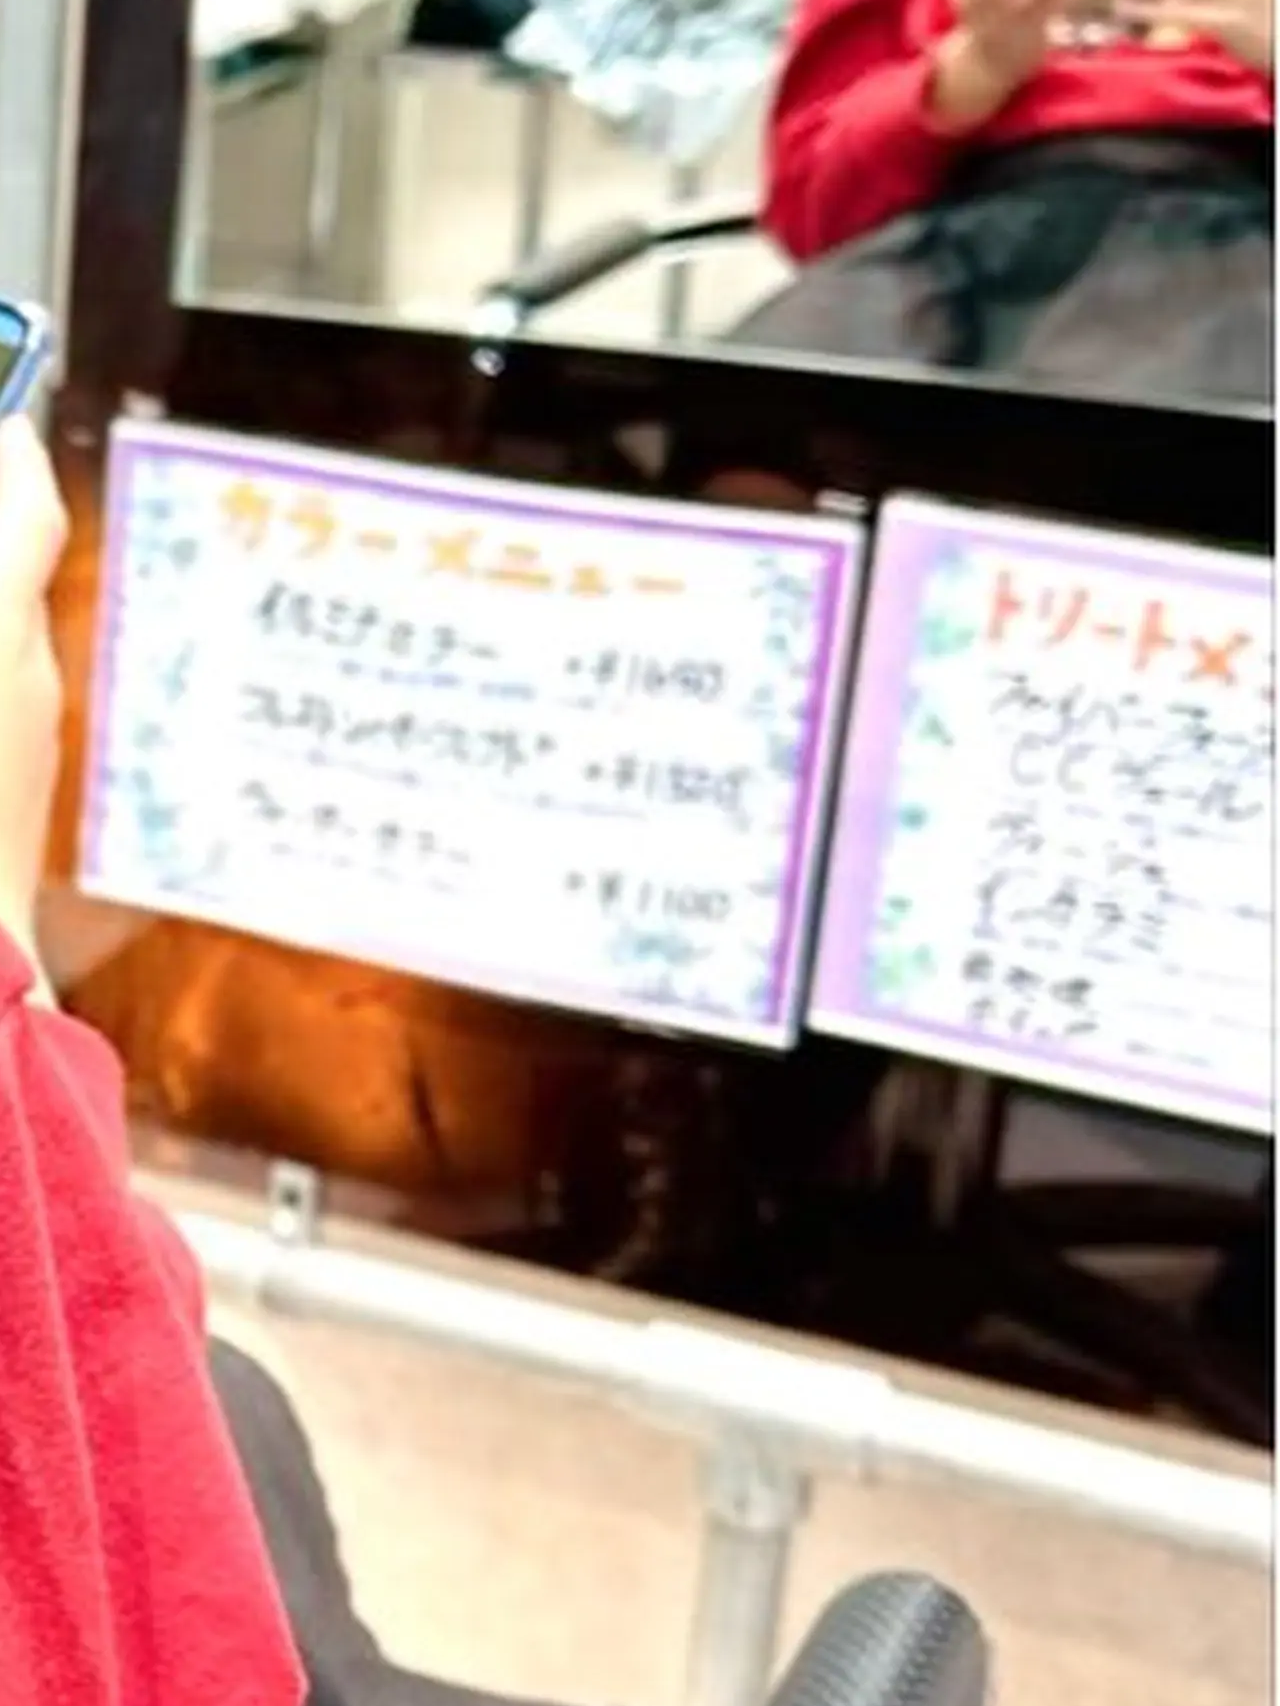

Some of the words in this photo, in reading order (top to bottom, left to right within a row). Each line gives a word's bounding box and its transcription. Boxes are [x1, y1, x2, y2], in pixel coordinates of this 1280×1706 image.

[986, 569, 1276, 705] トリートメ
